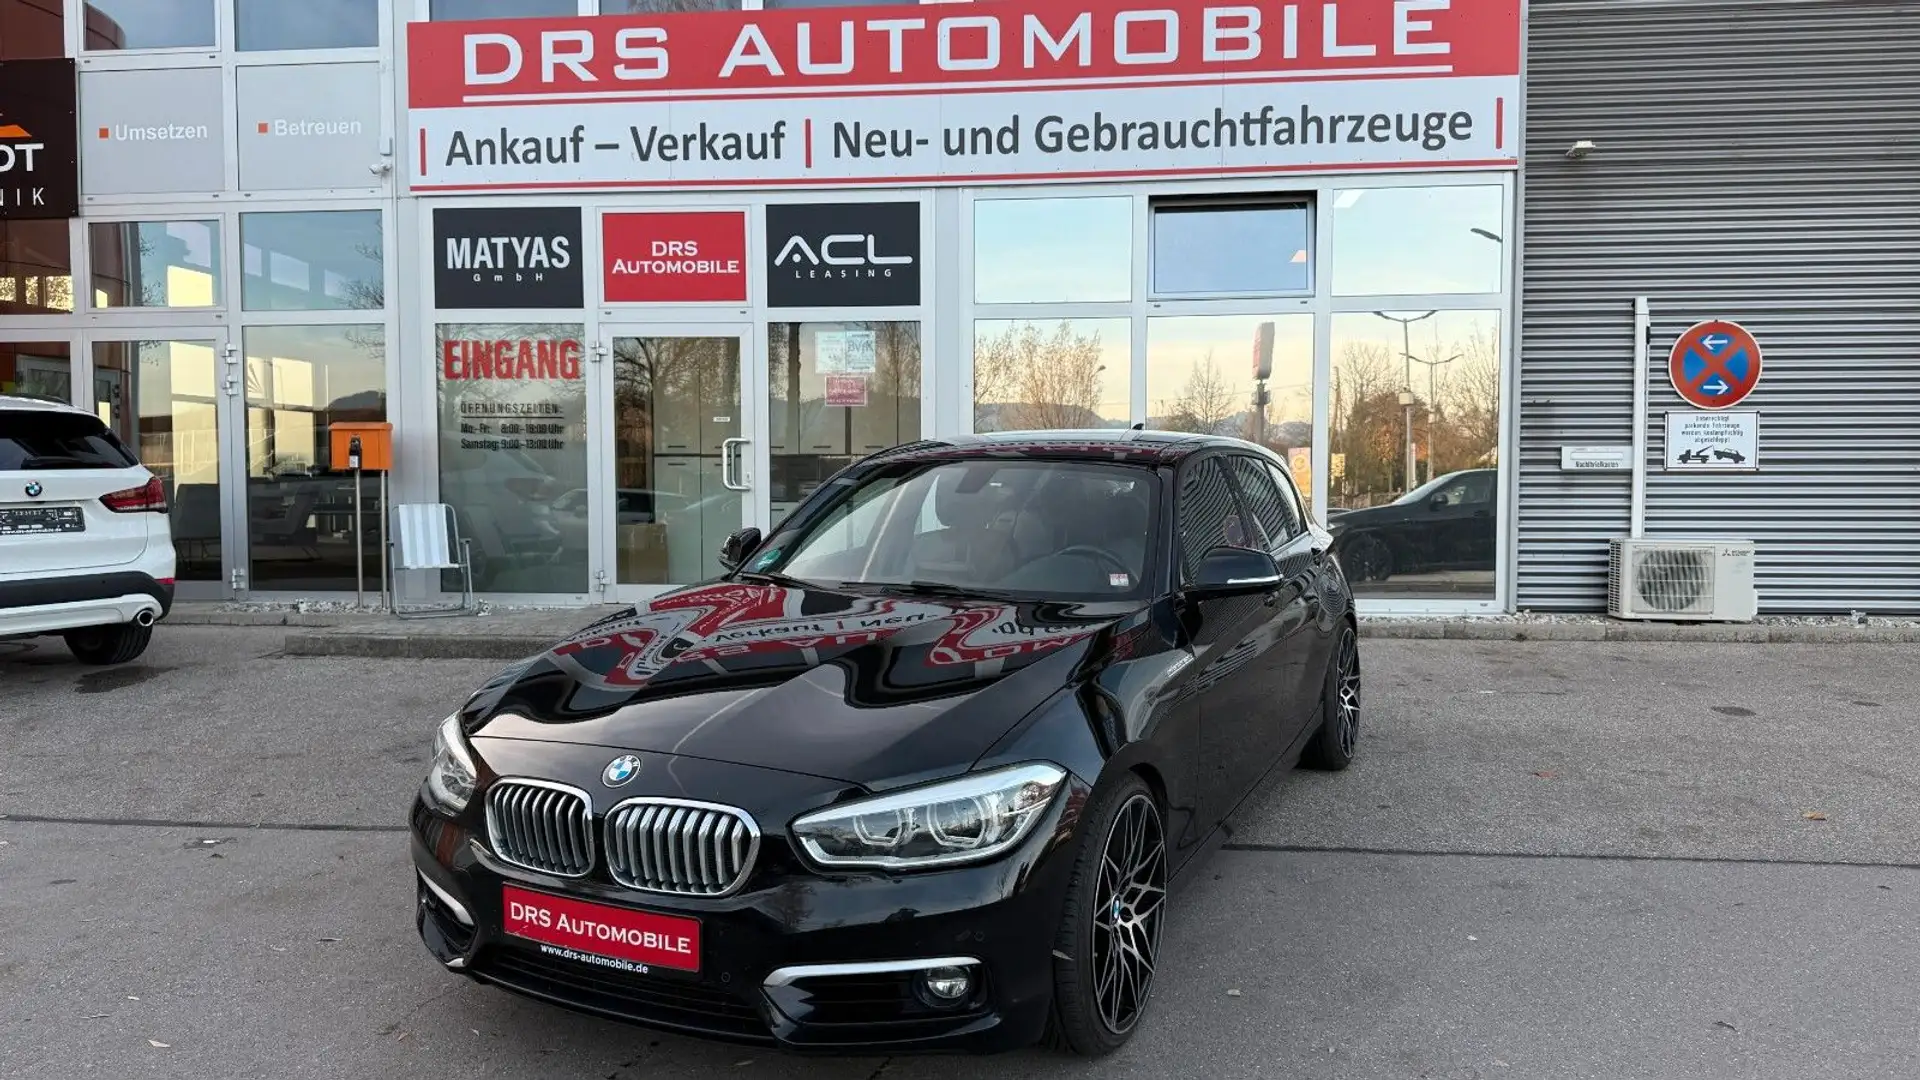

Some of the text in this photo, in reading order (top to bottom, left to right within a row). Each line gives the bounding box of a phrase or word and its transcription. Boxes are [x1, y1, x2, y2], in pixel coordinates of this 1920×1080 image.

[464, 0, 1451, 86] DRS AUTOMOBILE
[115, 123, 208, 141] Umsetzen
[274, 118, 362, 136] Betreuen
[446, 125, 585, 166] Ankauf
[630, 120, 786, 162] Verkauf
[833, 121, 929, 159] Neu-
[943, 115, 1019, 156] und
[1034, 105, 1473, 153] Gebrauchtfahrzeuge
[0, 187, 45, 206] IK
[446, 236, 570, 269] MATYAS
[651, 241, 698, 257] DRS
[774, 234, 914, 266] ACL
[795, 268, 893, 279] LEASING
[444, 339, 581, 379] EINGANG
[510, 902, 551, 927] DRS
[540, 944, 649, 974] www.drs-automobile.de
